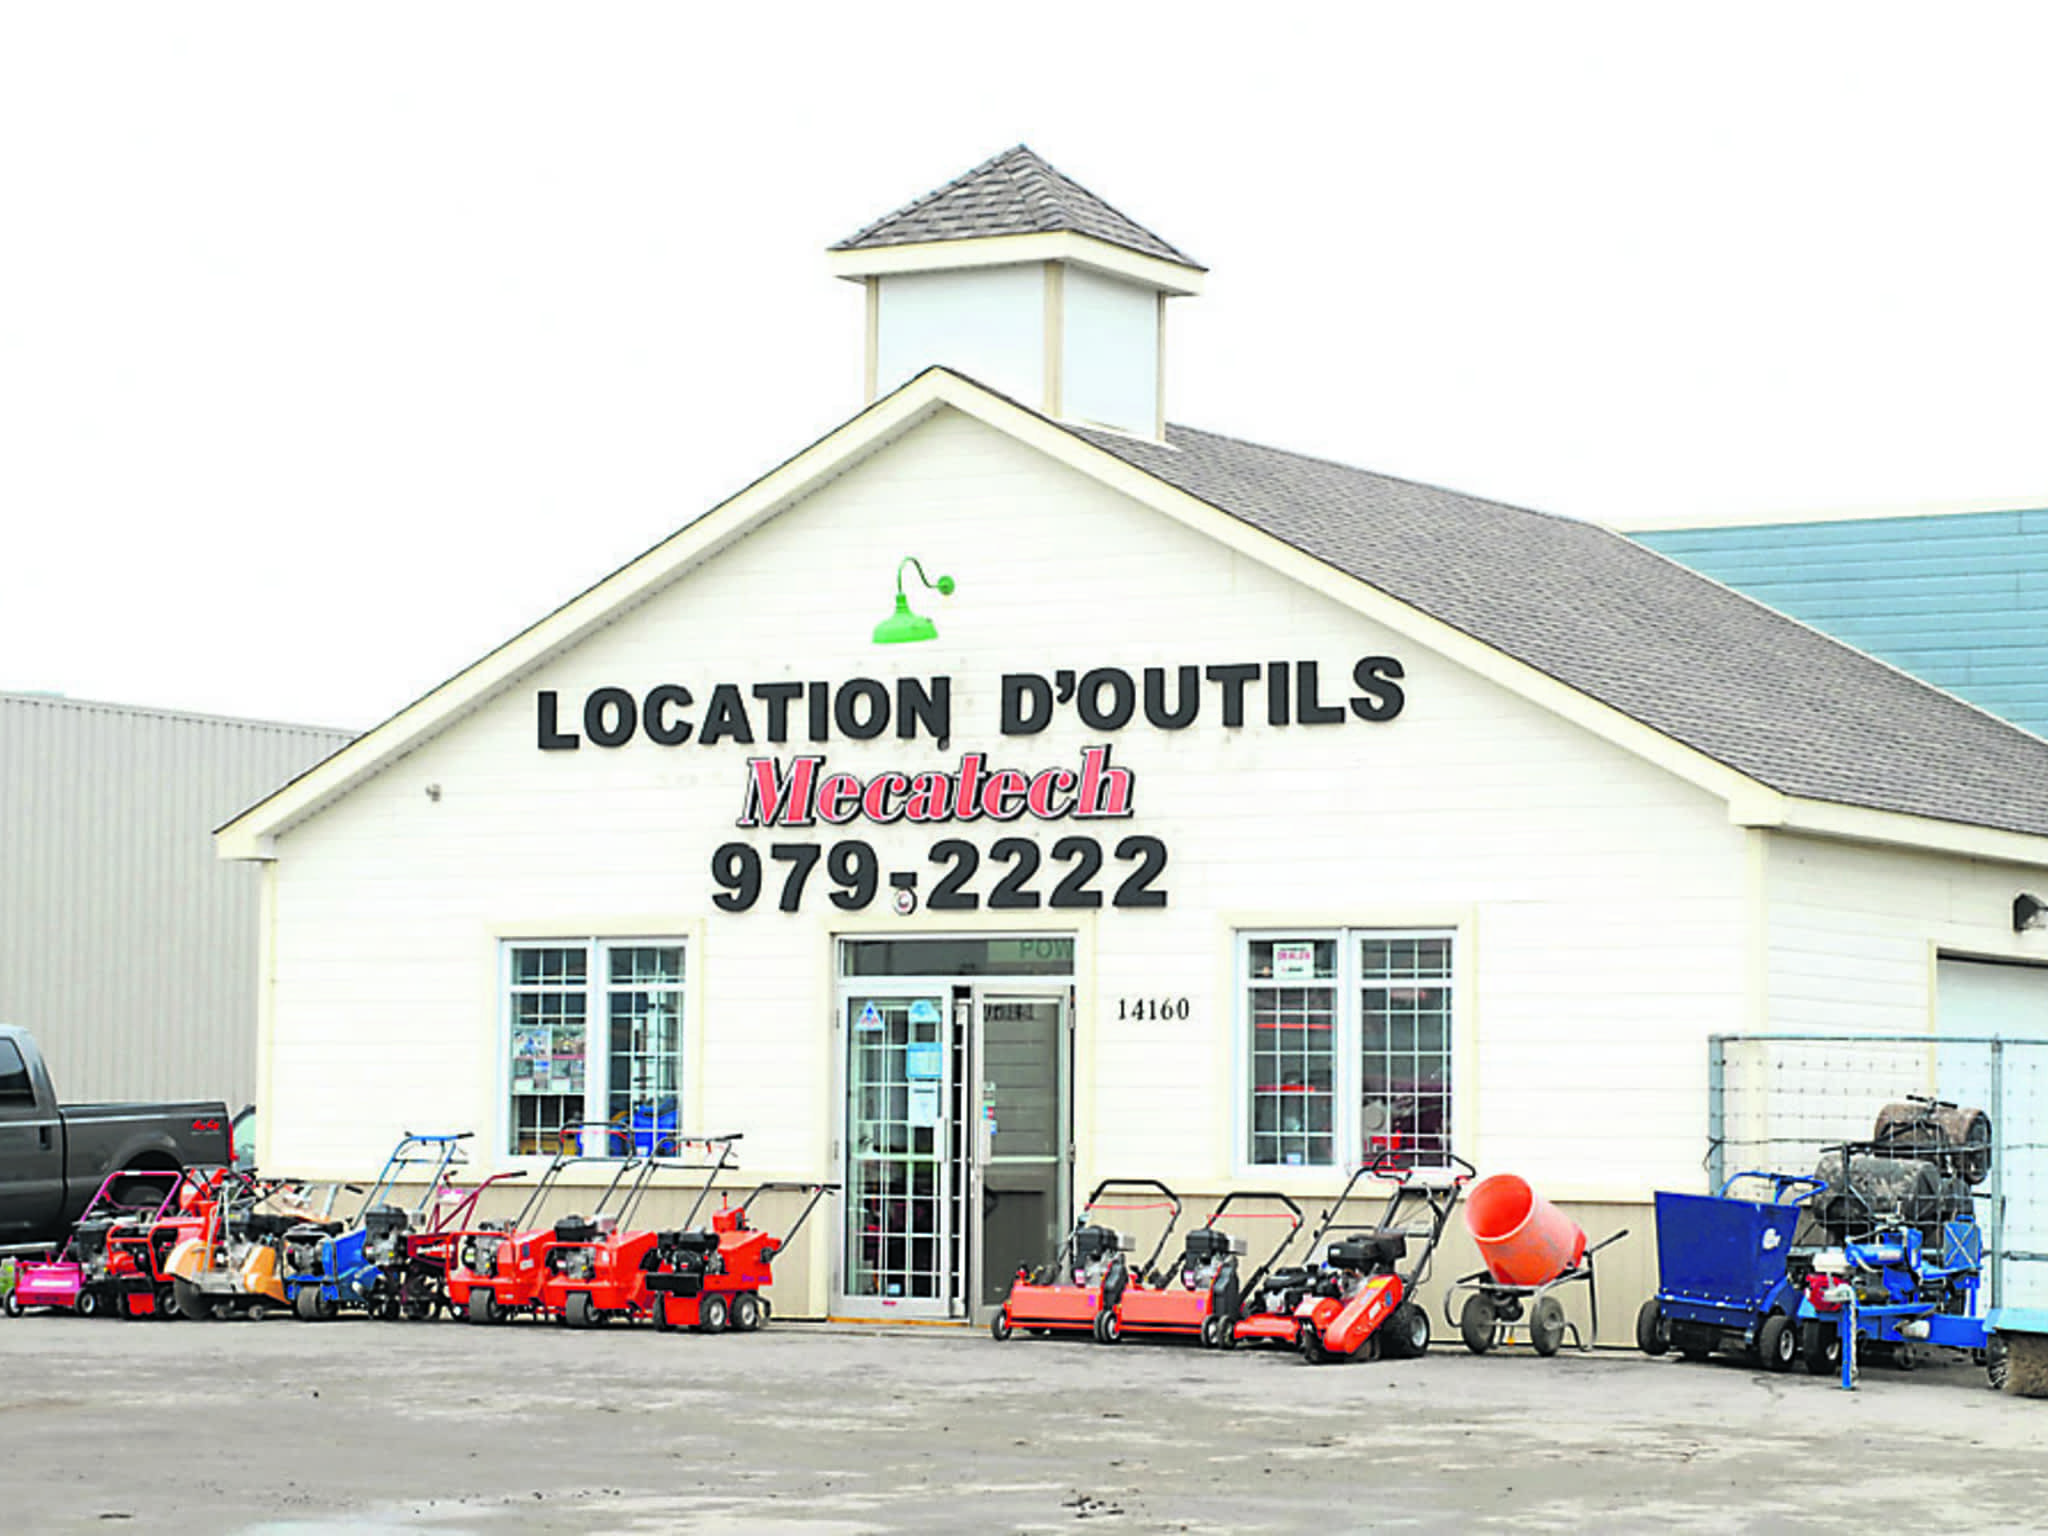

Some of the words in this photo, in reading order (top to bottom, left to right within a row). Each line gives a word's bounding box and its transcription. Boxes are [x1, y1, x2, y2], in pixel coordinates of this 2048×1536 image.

[537, 677, 951, 750] LOCATION
[1001, 656, 1405, 736] D'OUTILS
[736, 743, 1134, 828] Mecatech
[711, 836, 1168, 913] 979-2222
[1118, 997, 1190, 1021] 14160
